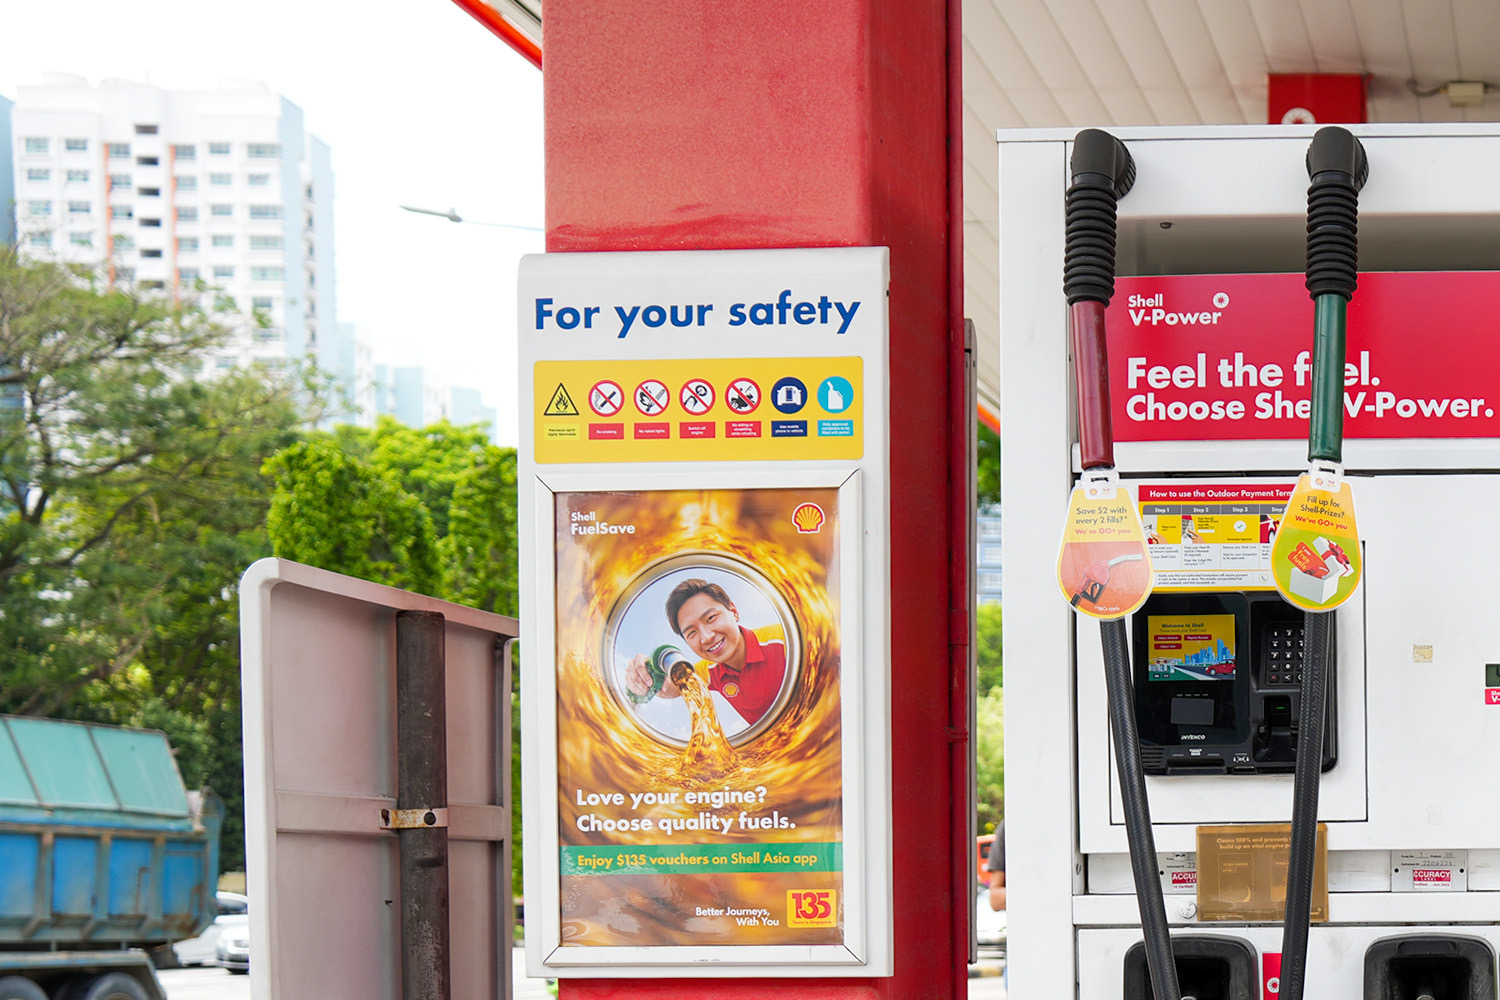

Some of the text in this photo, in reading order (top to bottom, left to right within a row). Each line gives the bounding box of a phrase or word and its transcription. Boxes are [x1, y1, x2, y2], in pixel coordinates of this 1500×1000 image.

[1128, 294, 1163, 308] Shell
[535, 290, 861, 338] For your safety
[1129, 309, 1222, 326] V-Power
[1127, 351, 1380, 389] Feel the fel.
[1126, 391, 1495, 421] Choose She V-Power.
[1150, 490, 1167, 498] How
[1169, 490, 1177, 498] to
[1194, 490, 1206, 498] the
[1207, 489, 1239, 498] Outdoor
[1241, 490, 1274, 499] Payment
[1307, 496, 1319, 504] Fill
[1330, 499, 1341, 508] for
[571, 511, 596, 522] Shell
[1076, 506, 1127, 515] Save $2 with
[1300, 504, 1345, 519] Shell-Prizes?
[1075, 517, 1098, 525] every
[1100, 516, 1105, 524] 2
[1295, 515, 1316, 524] We've
[1317, 518, 1334, 527] GO+
[570, 522, 636, 536] FuelSave
[1075, 527, 1131, 537] We've GO+ you
[576, 786, 767, 809] Love your engine?
[576, 811, 796, 835] Choose quality fuels.
[577, 852, 818, 869] Enjoy $135 vouchers on Shell Asia app
[695, 906, 770, 919] Better Journeys,
[792, 892, 832, 919] 135
[736, 917, 779, 927] With You
